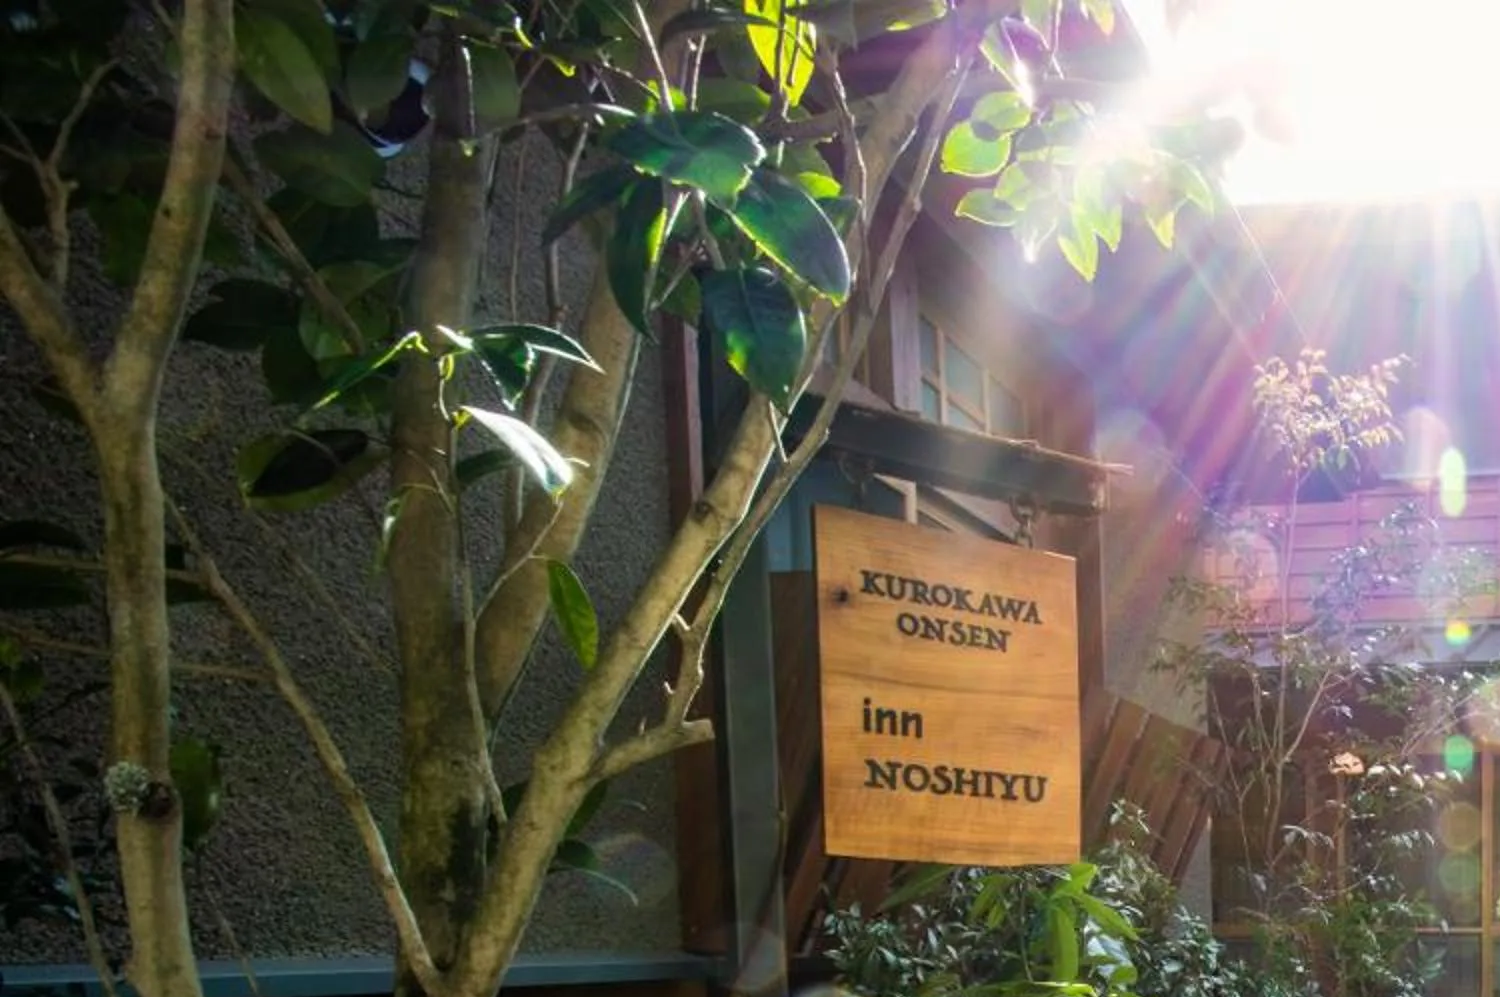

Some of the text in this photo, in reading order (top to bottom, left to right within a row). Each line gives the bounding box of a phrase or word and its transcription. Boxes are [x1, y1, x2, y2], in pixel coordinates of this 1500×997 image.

[860, 570, 1043, 625] KUROKAWA
[897, 613, 1012, 653] ONSEN
[861, 698, 924, 739] inn
[863, 759, 1048, 803] NOSHIYU
